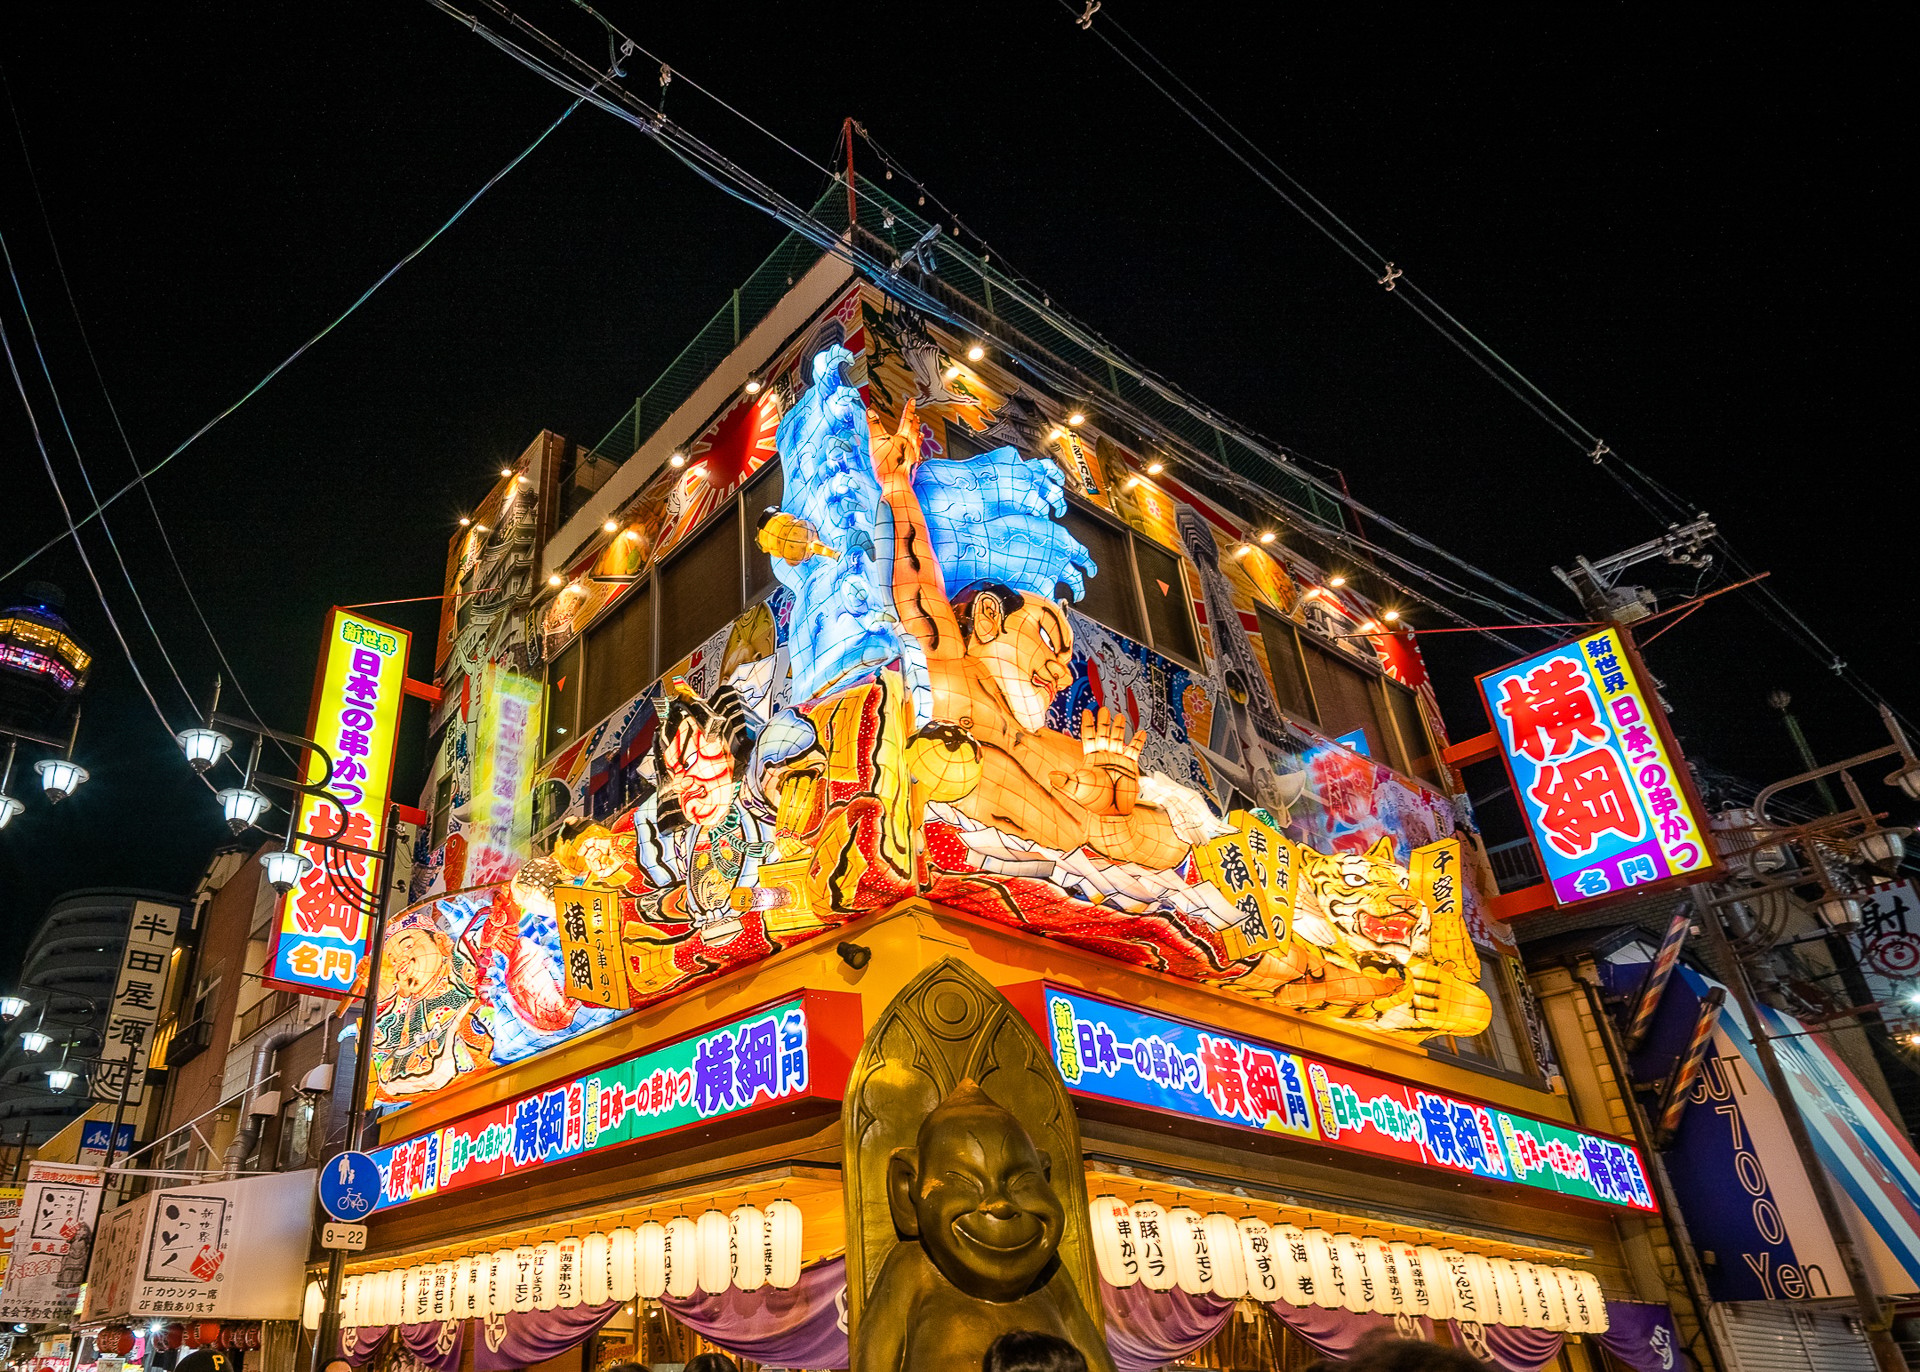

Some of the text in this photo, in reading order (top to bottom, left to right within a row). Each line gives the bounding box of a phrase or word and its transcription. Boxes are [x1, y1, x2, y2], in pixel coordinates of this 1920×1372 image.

[343, 621, 397, 656] 新世界
[1586, 635, 1629, 695] 新世界
[330, 648, 382, 806] 日本一の串かつ
[1502, 659, 1642, 856] 横綱
[1611, 695, 1699, 869] 日本一の串かつ
[296, 804, 373, 942] 横綱
[1578, 858, 1655, 894] 名門
[291, 945, 356, 981] 名門
[563, 901, 594, 991] 横綱
[99, 913, 174, 1087] 半田屋酒店
[694, 1020, 778, 1114] 横綱
[781, 1014, 807, 1090] 名門
[1053, 1000, 1080, 1080] 新世界
[1077, 1022, 1201, 1091] 日本一の串かつ
[600, 1071, 691, 1128] 日本一の串かつ
[1200, 1037, 1288, 1125] 横綱
[1280, 1059, 1310, 1129] 名門
[86, 1130, 129, 1147] Ashi
[514, 1090, 565, 1163] 横綱
[567, 1086, 582, 1149] 名門
[1331, 1085, 1423, 1144] 日本一の串かつ
[1420, 1095, 1489, 1169] 横綱
[389, 1139, 427, 1199] 横綱
[425, 1137, 438, 1189] 名門
[452, 1127, 512, 1171] 日本一の串かつ
[1579, 1137, 1638, 1201] 横綱
[1117, 1219, 1139, 1275] 串かつ
[1140, 1220, 1166, 1277] 豚バラ
[1192, 1227, 1213, 1283] ホルモン
[1251, 1236, 1276, 1290] 砂ずり
[1290, 1243, 1315, 1295] 海老
[1328, 1247, 1346, 1296] ほたて
[142, 1286, 218, 1300] 1F カウンター席
[417, 1277, 430, 1316] ホルモン
[515, 1262, 530, 1304] サーモン
[558, 1253, 574, 1300] 海幸串かつ
[1355, 1251, 1375, 1302] サーモン
[1451, 1264, 1477, 1313] にんにく
[1743, 1253, 1831, 1300] Yen
[139, 1300, 216, 1313] 2F 座敷あります
[212, 1355, 225, 1371] P
